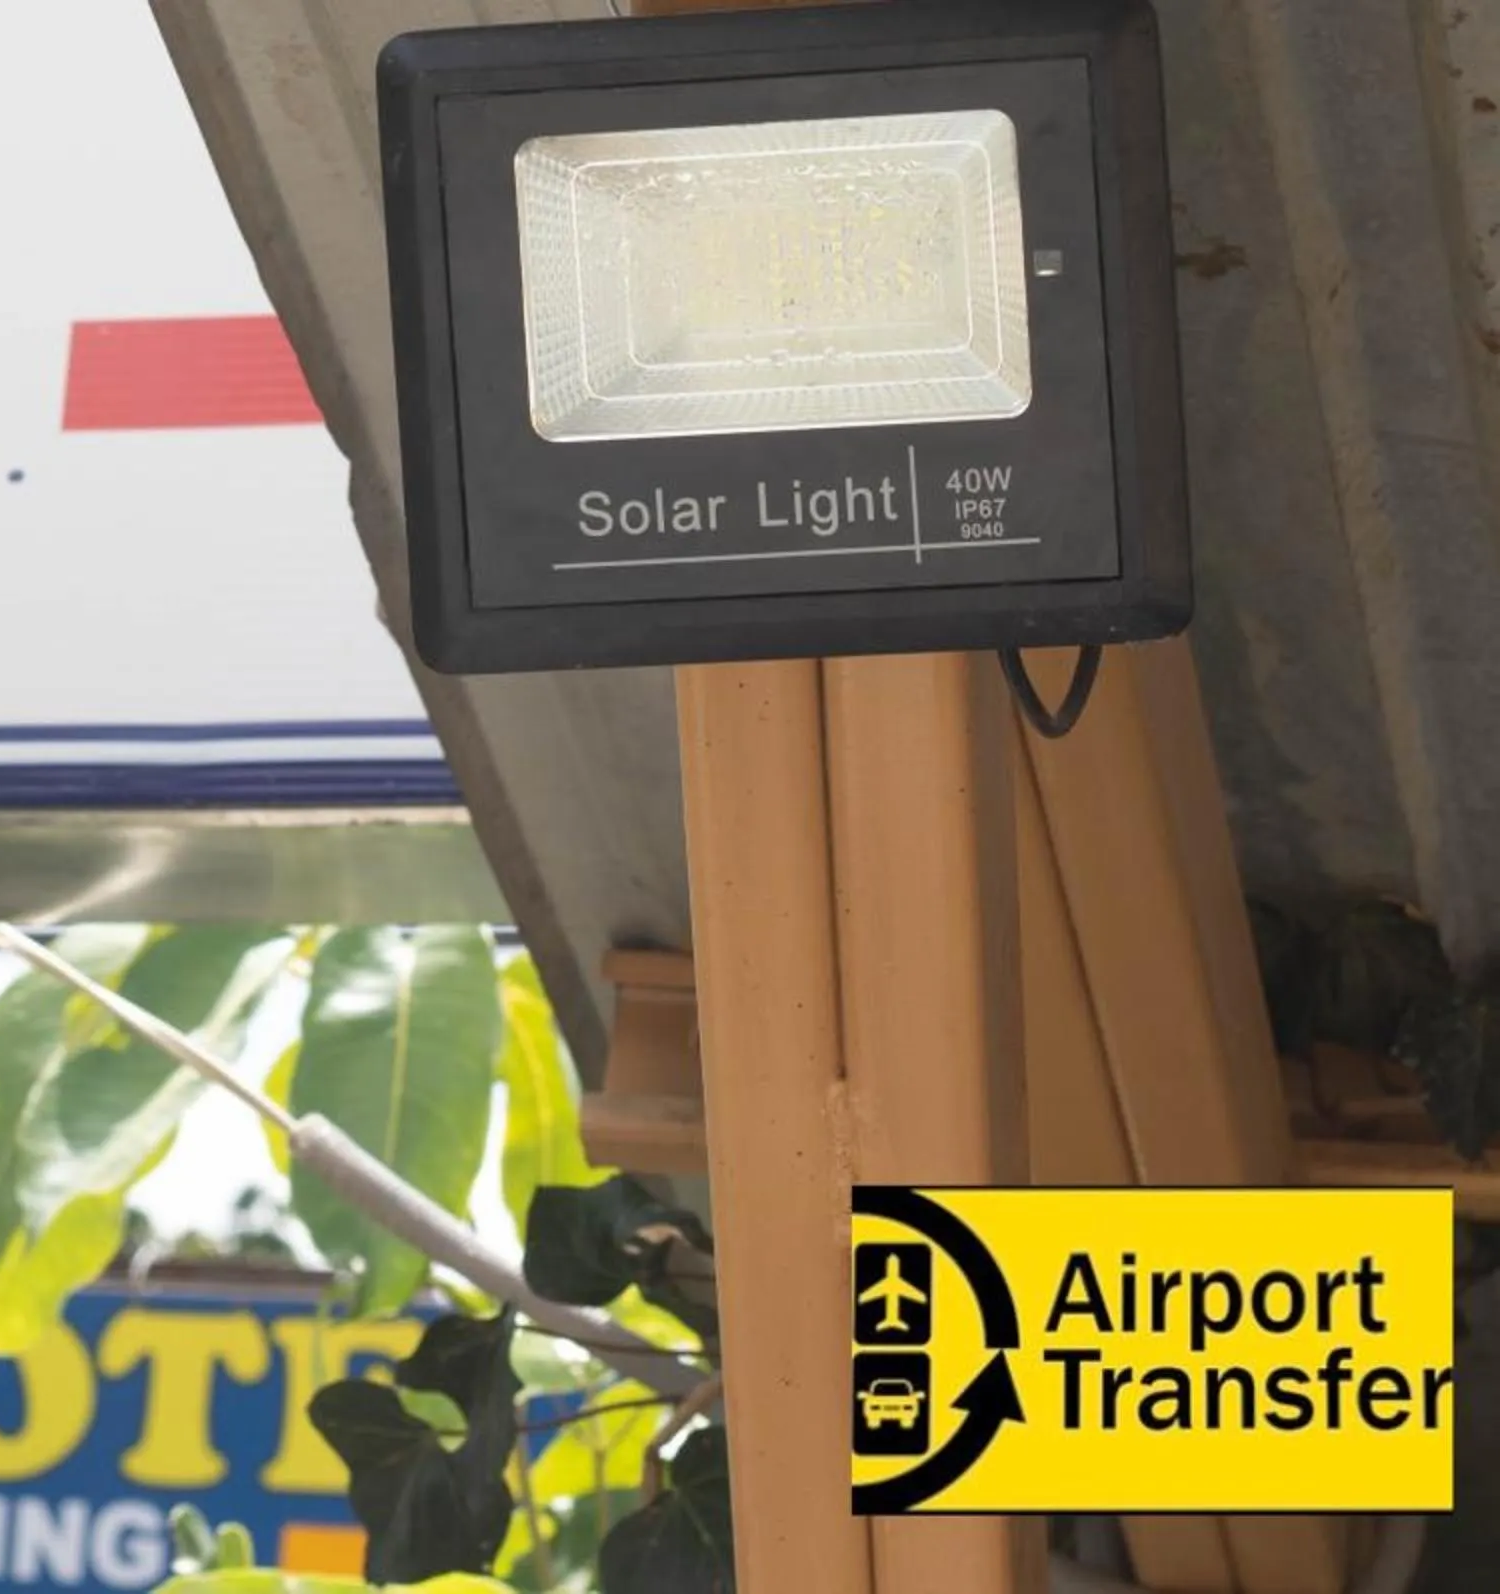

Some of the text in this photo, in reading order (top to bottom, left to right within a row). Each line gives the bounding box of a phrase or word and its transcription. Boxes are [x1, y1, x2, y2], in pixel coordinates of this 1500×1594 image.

[945, 465, 1012, 494] 40W
[578, 475, 898, 537] Solar Light
[955, 497, 1006, 520] IP67
[961, 521, 1004, 539] 9040
